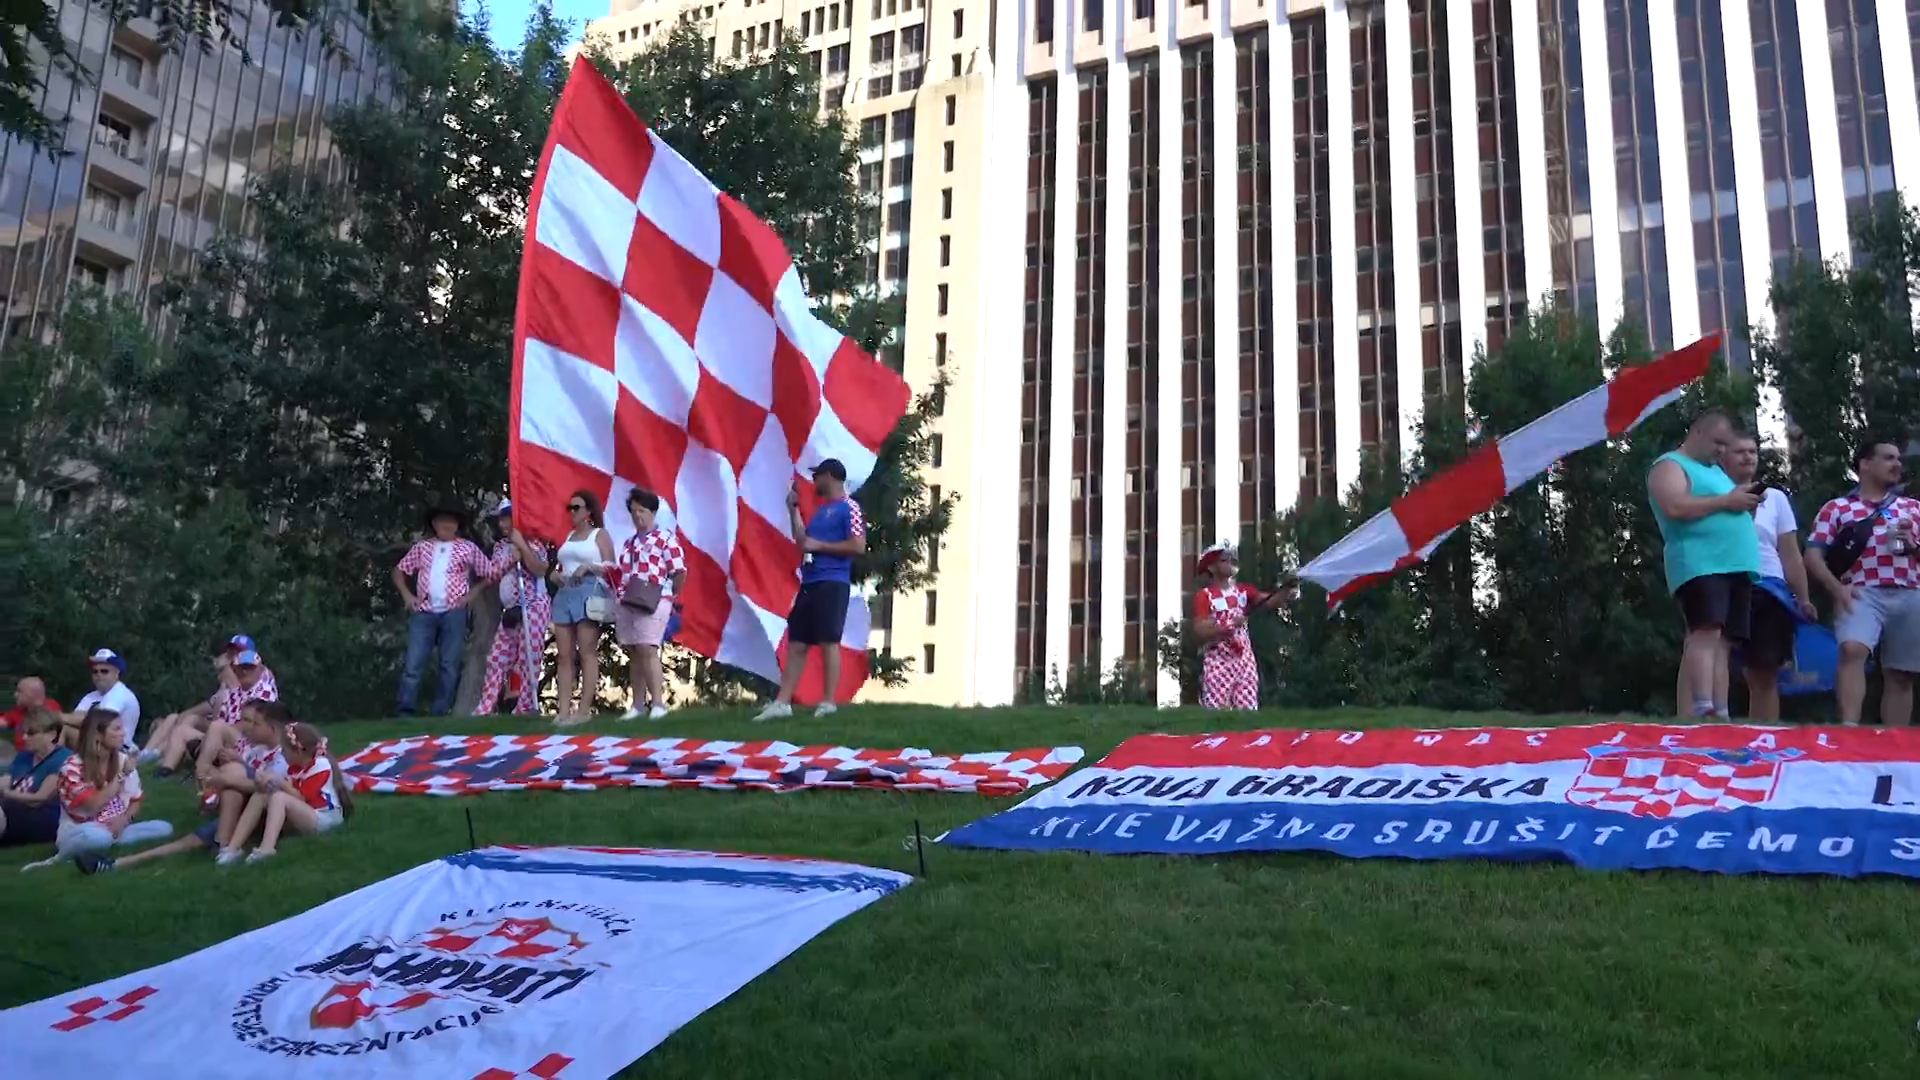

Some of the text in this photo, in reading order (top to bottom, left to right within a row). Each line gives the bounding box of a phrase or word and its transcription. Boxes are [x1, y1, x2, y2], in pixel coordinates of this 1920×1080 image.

[1602, 730, 1686, 747] JE
[1066, 775, 1222, 801] NOVA
[1225, 772, 1550, 799] GRADIŠKA
[1029, 812, 1153, 839] NIJE
[1163, 812, 1358, 844] VAŽNO
[1373, 815, 1625, 846] SRUŠIT
